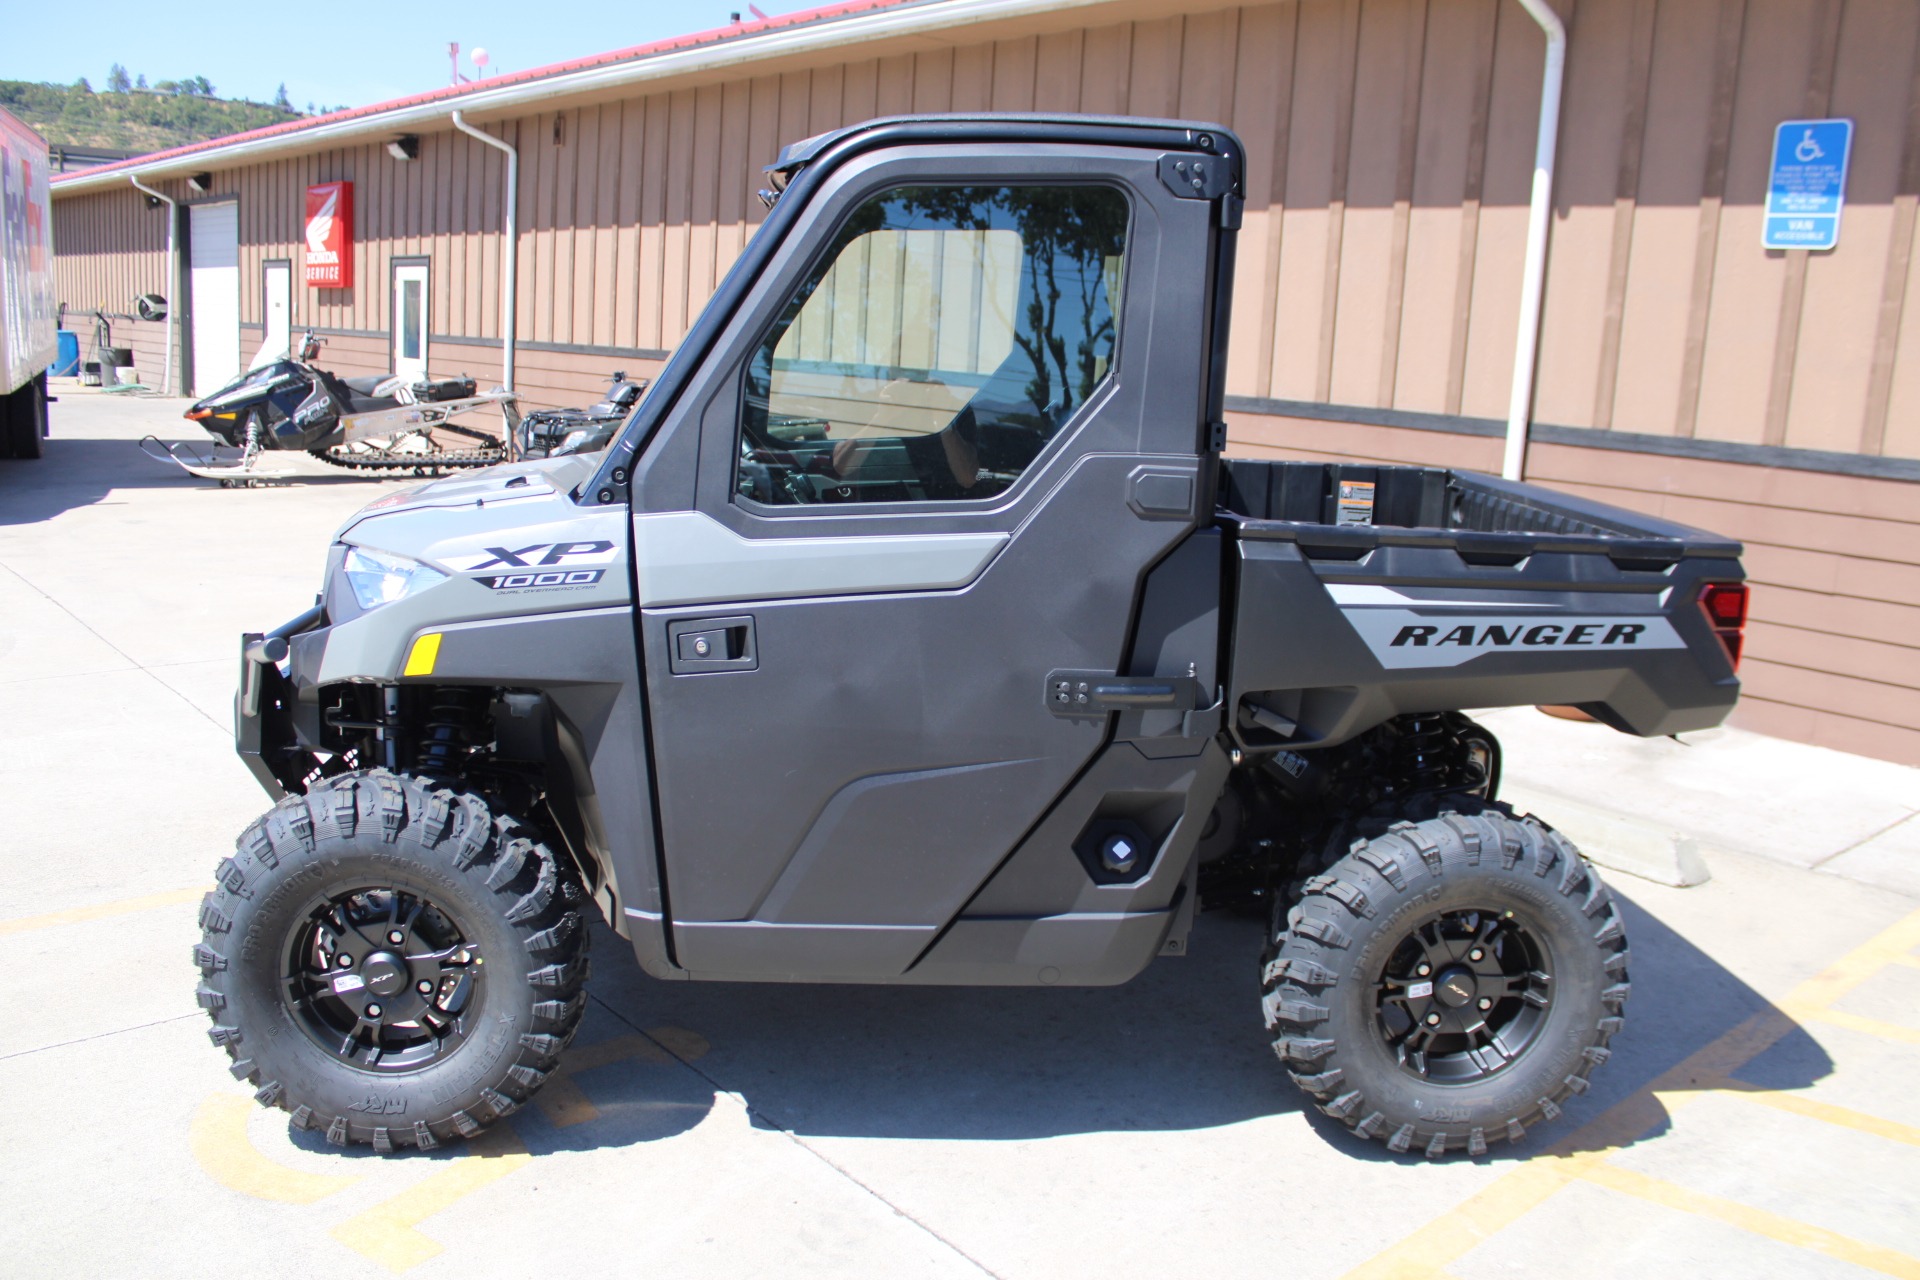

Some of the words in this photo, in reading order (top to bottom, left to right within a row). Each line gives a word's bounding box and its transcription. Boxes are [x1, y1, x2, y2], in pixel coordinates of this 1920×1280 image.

[1787, 219, 1815, 231] VAN
[1773, 231, 1826, 241] ACCESSIBLE
[306, 251, 339, 264] HONDA
[306, 266, 340, 280] SERVICE
[293, 395, 331, 424] PRO
[465, 540, 615, 570] XP
[492, 571, 597, 589] 1000
[523, 586, 574, 594] OVERHEAD
[1389, 624, 1647, 647] RANGER
[369, 972, 394, 985] XP
[1447, 983, 1469, 997] XP
